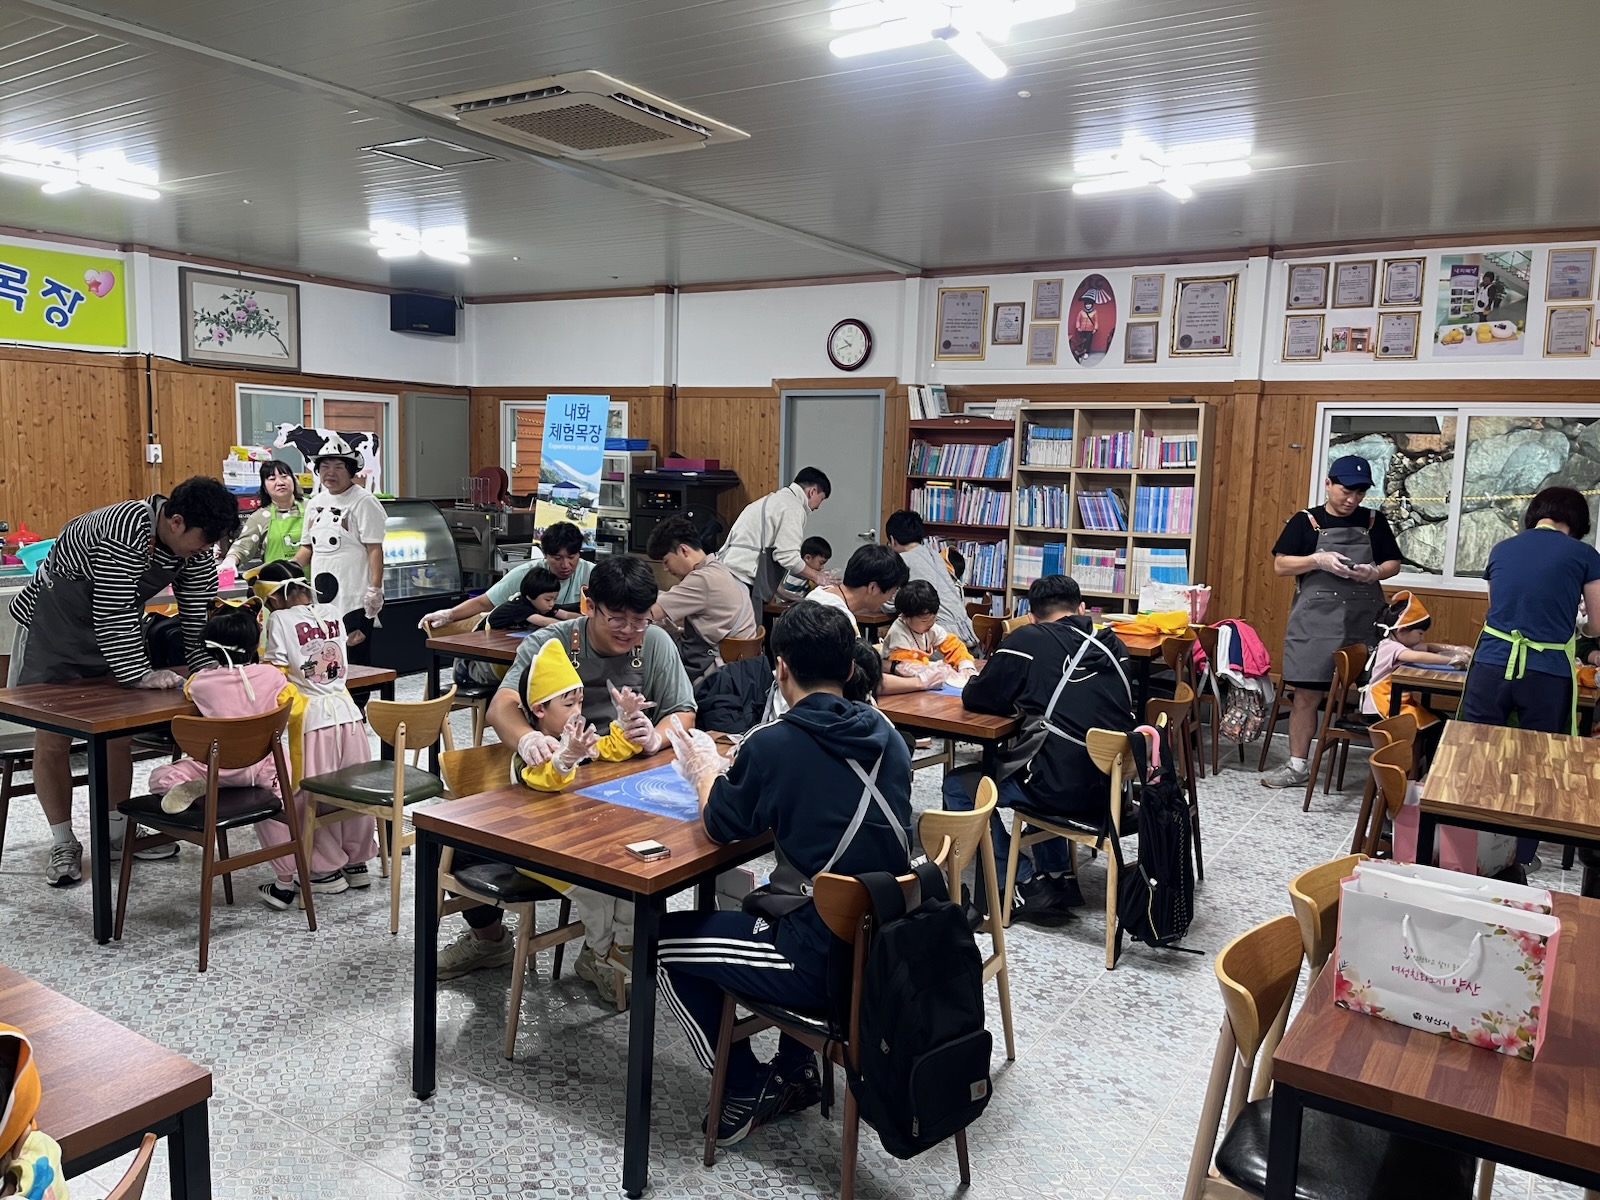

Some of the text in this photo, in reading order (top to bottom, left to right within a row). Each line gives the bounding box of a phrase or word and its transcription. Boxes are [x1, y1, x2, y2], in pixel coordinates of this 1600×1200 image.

[0, 262, 84, 328] 목장
[564, 403, 590, 422] 내화
[548, 423, 602, 443] 체험목장
[1452, 977, 1481, 996] 양산
[1424, 1015, 1450, 1028] 양산시
